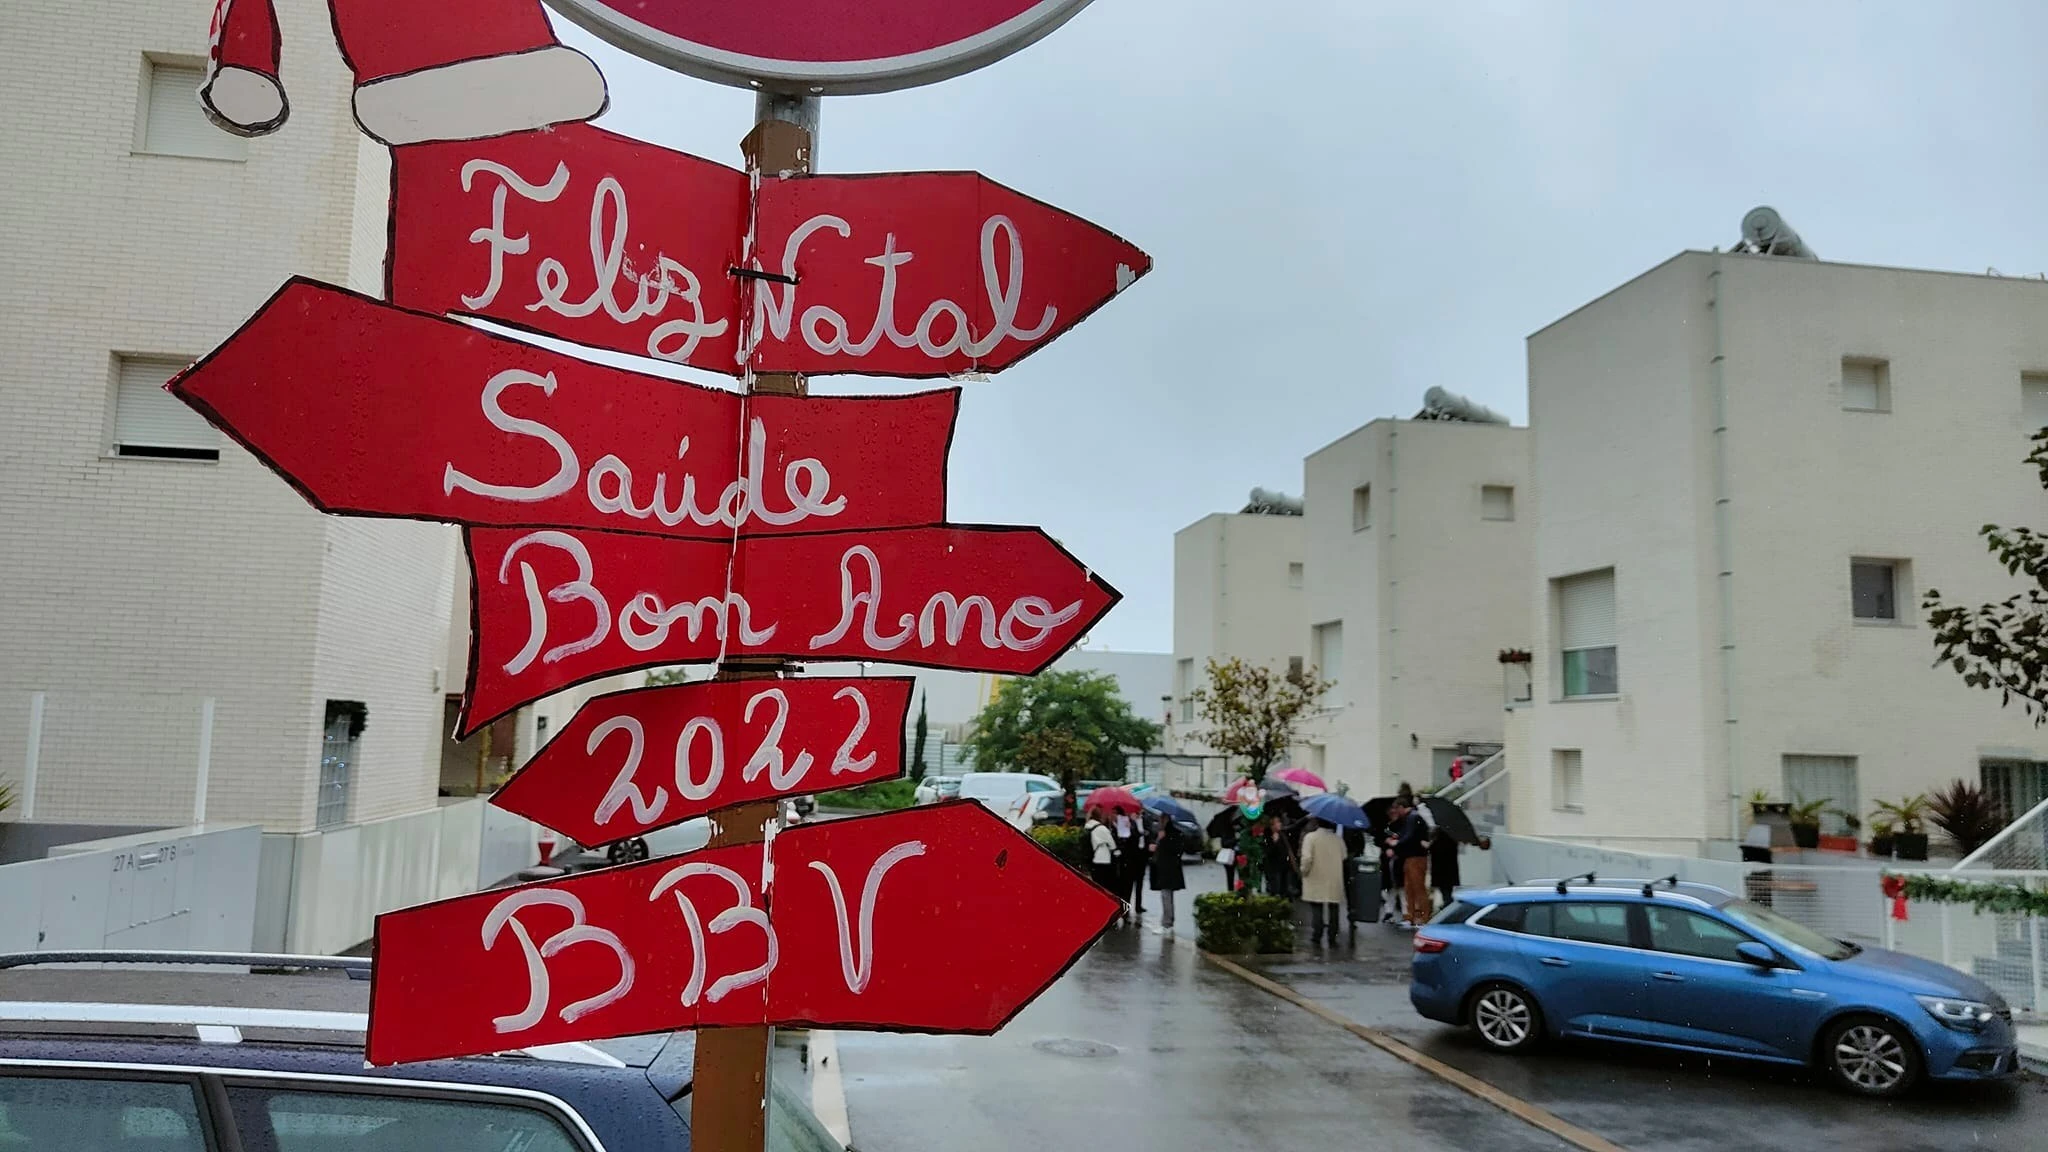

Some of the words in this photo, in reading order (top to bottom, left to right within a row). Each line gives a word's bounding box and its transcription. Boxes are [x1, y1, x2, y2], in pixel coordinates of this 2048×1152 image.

[461, 159, 729, 364] Feliz
[751, 213, 1058, 359] Natal
[445, 369, 848, 527] Saúde
[499, 530, 779, 675] Bom
[587, 686, 876, 825] 2022
